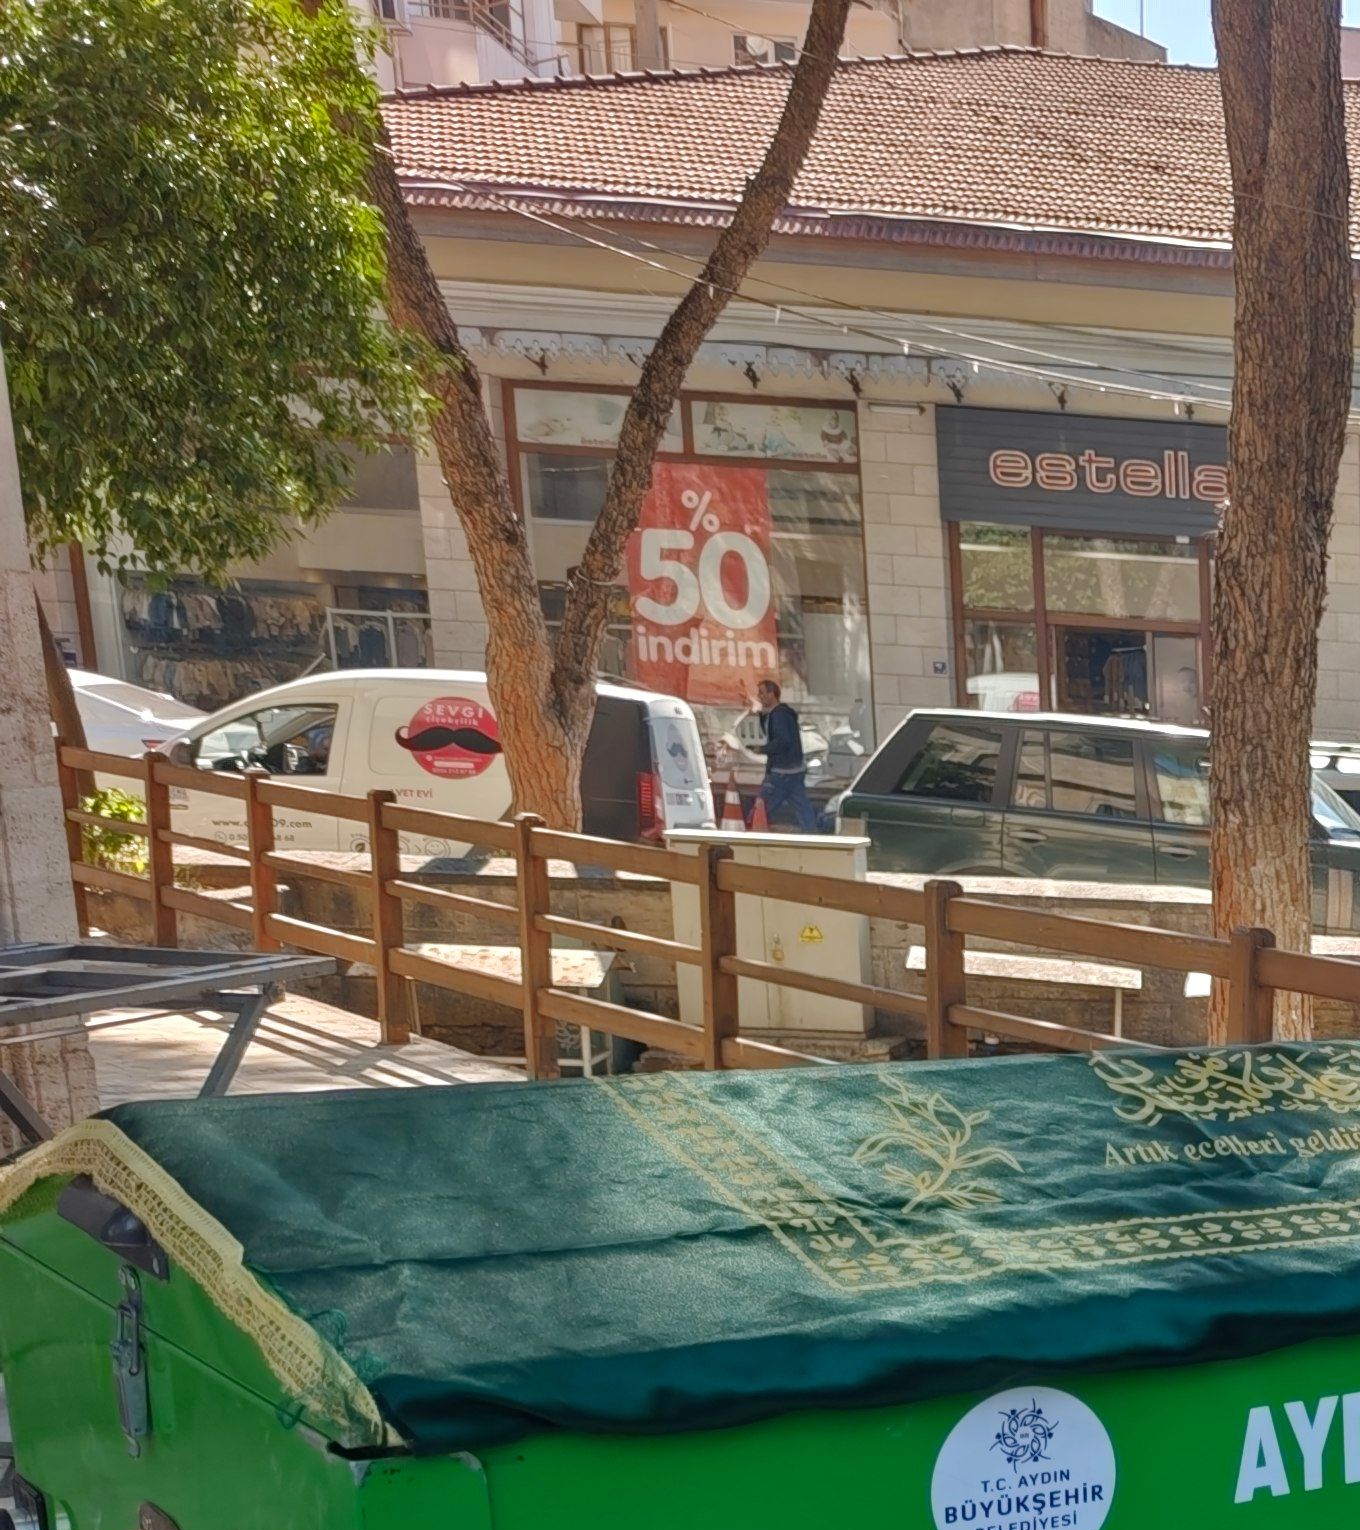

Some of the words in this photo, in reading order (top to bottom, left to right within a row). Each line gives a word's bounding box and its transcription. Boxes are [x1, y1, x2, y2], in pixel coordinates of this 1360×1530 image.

[988, 449, 1231, 502] estella
[635, 528, 771, 629] 50
[636, 625, 777, 669] indirim
[1105, 1140, 1178, 1168] Artık
[1183, 1132, 1287, 1162] ecelleri
[981, 1478, 1012, 1493] T.C.
[1018, 1469, 1070, 1489] AYDIN
[945, 1482, 1104, 1524] BÜYÜKŞEHİR
